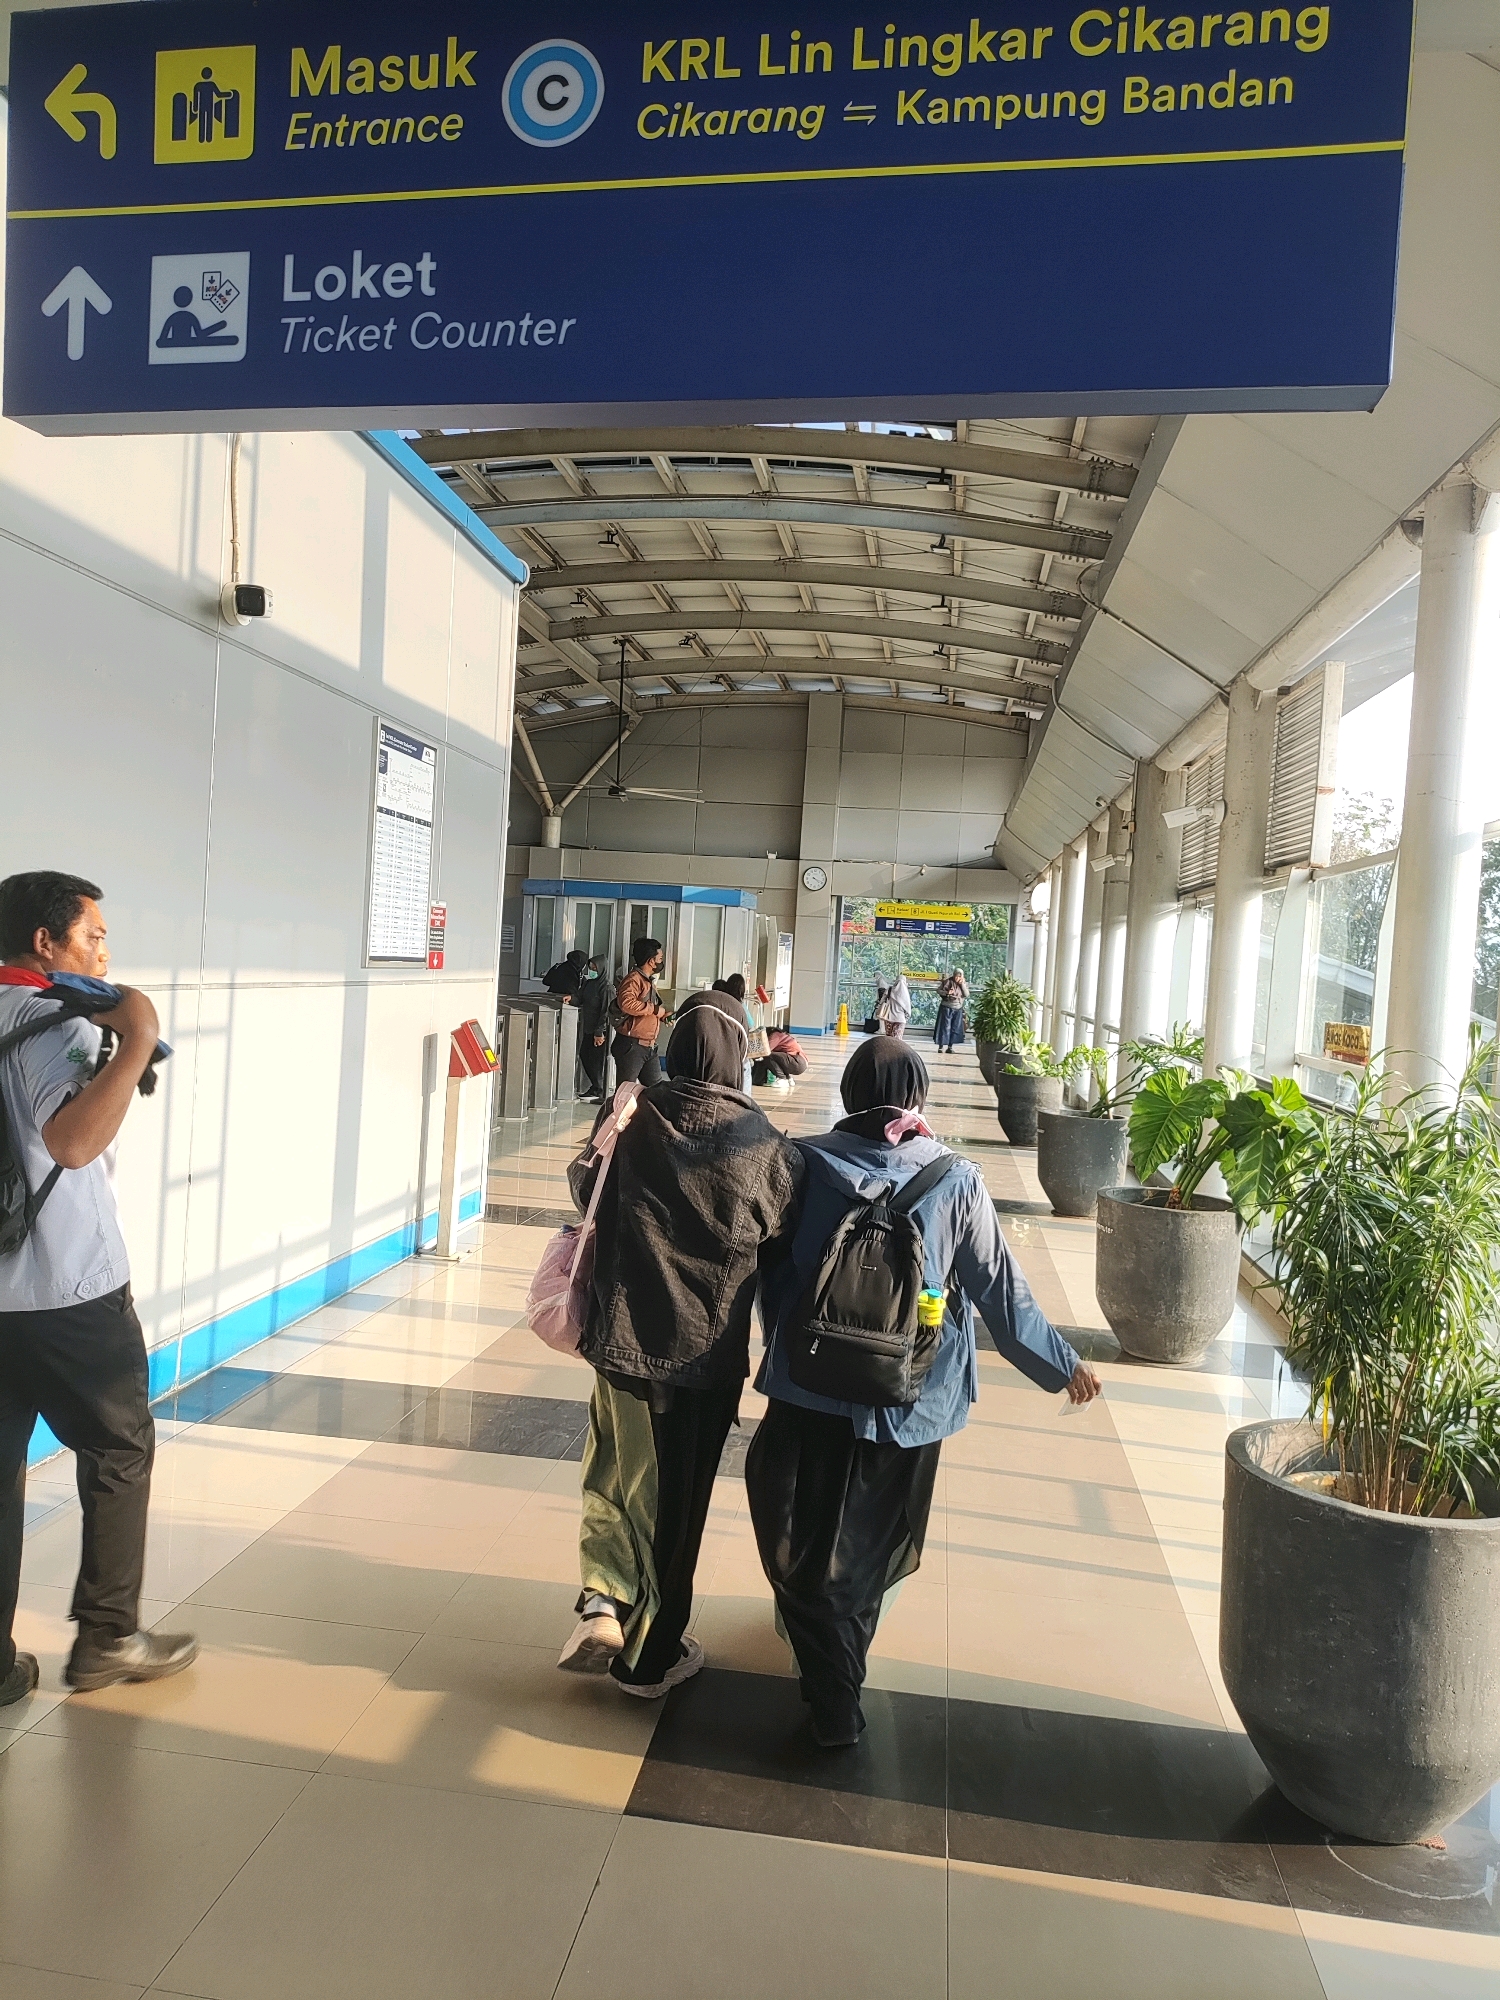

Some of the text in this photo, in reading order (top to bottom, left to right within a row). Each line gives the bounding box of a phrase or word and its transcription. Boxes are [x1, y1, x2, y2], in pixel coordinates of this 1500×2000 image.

[290, 37, 477, 97] Masuk
[642, 6, 1330, 83] KRL Lin Lingkar Cikarang
[536, 74, 570, 111] C
[636, 69, 1294, 139] Cikarang Kampung Bandan
[284, 113, 464, 150] Entrance
[283, 250, 437, 301] Loket
[280, 312, 577, 352] Ticket Counter
[1342, 1029, 1360, 1049] Kaca
